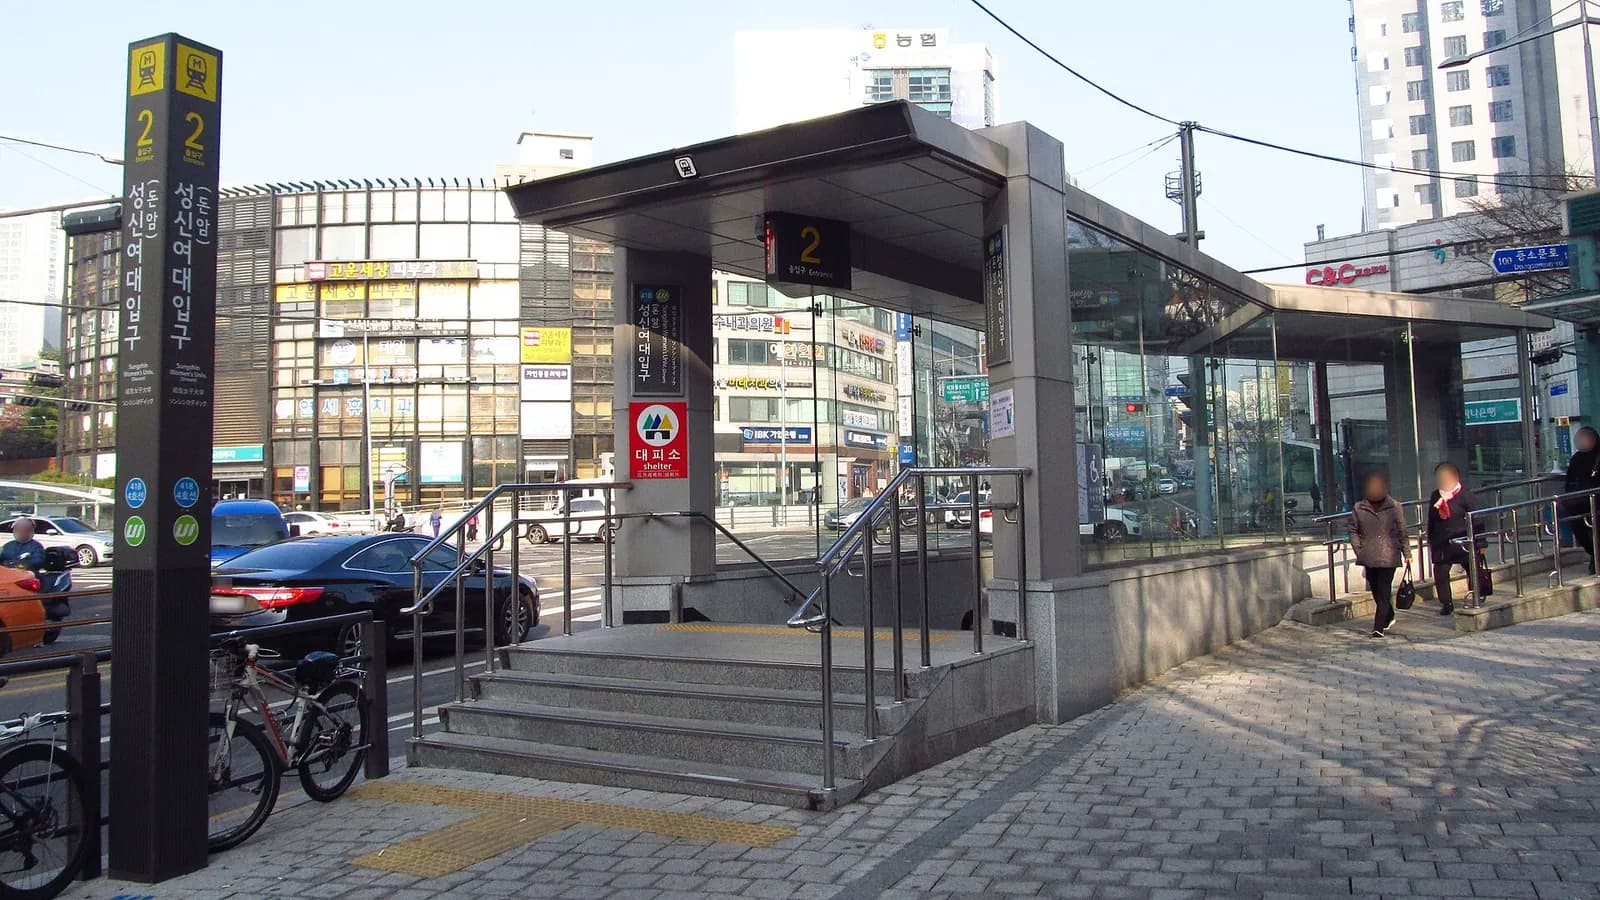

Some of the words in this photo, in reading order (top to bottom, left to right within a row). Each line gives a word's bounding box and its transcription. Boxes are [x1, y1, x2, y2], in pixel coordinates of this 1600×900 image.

[896, 33, 937, 47] 농협
[136, 109, 153, 147] 2
[185, 112, 205, 151] 2
[146, 180, 160, 239] (돈암)
[195, 186, 212, 245] (돈암)
[800, 226, 821, 264] 2
[1516, 248, 1560, 262] 동소문로
[124, 183, 145, 352] 성신여대입구
[170, 183, 193, 350] 성신여대입구
[1306, 264, 1356, 286] C&C
[1498, 257, 1512, 266] 100
[714, 315, 773, 331] 수내과의원
[638, 304, 651, 382] 성신여대입구
[635, 448, 681, 461] 대피소
[643, 462, 672, 471] shelter
[130, 482, 142, 490] 418
